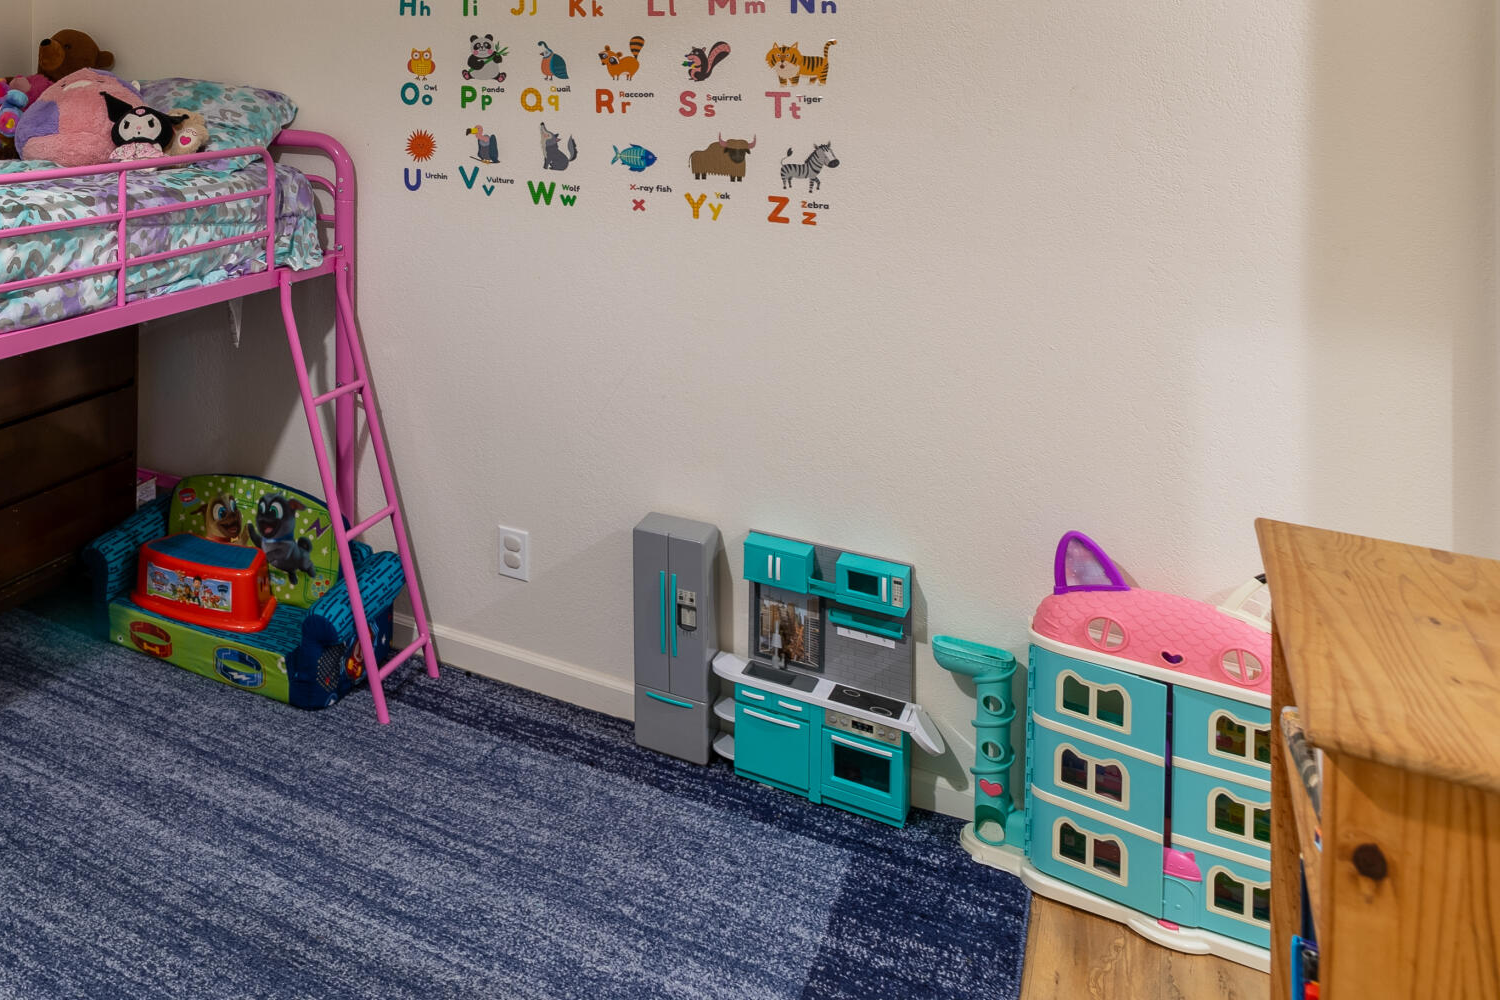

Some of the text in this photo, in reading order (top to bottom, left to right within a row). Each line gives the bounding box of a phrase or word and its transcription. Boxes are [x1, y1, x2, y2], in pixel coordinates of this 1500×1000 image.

[550, 85, 571, 93] Quail
[619, 90, 654, 99] Raccoon
[706, 93, 742, 103] Squirrel
[797, 94, 823, 104] Tiger
[404, 167, 422, 191] U
[425, 172, 448, 181] Urchin
[486, 176, 515, 185] Vulture
[561, 183, 581, 193] Wolf
[629, 183, 672, 193] X-ray fish
[714, 191, 730, 200] Yak
[800, 200, 829, 210] Zebra
